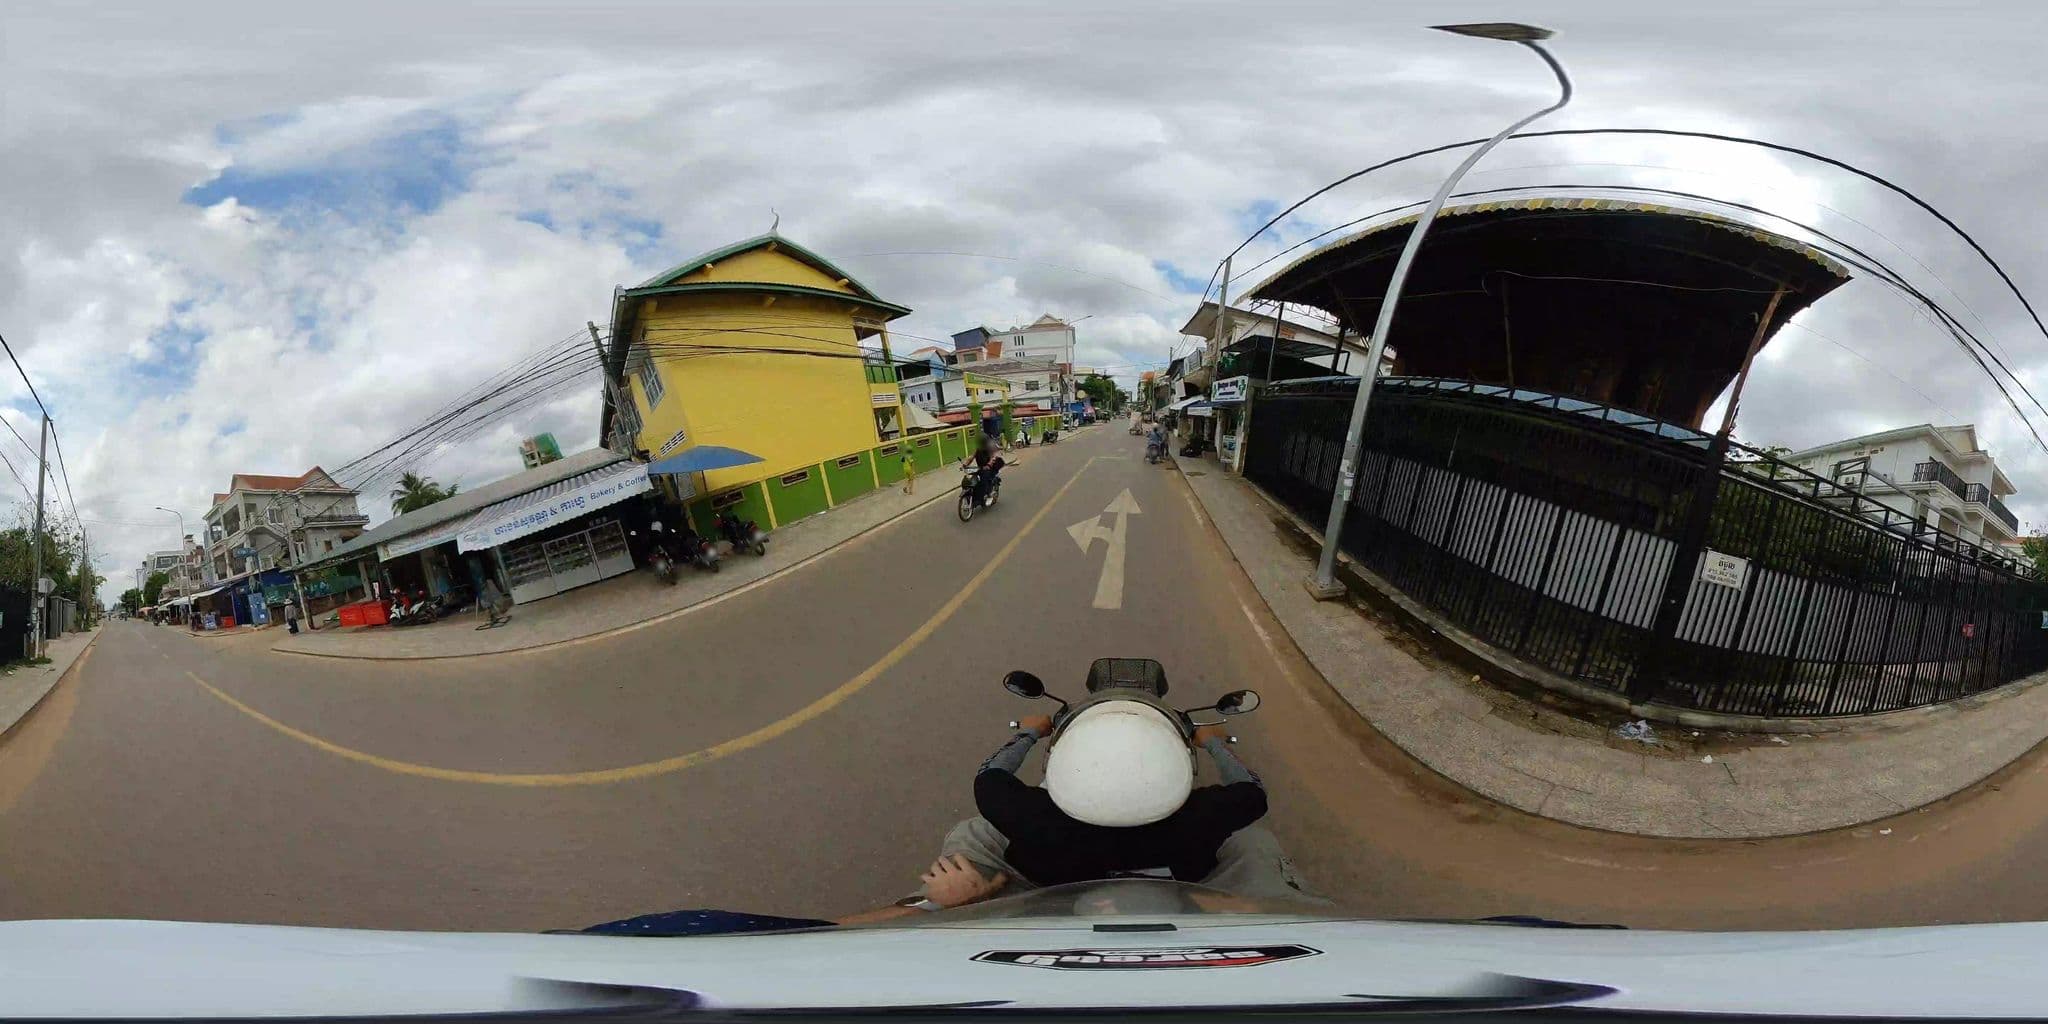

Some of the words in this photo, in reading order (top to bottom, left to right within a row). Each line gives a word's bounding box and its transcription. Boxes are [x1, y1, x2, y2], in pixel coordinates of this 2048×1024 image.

[590, 487, 616, 500] Bakery
[617, 482, 624, 491] &
[625, 475, 647, 487] Coffee
